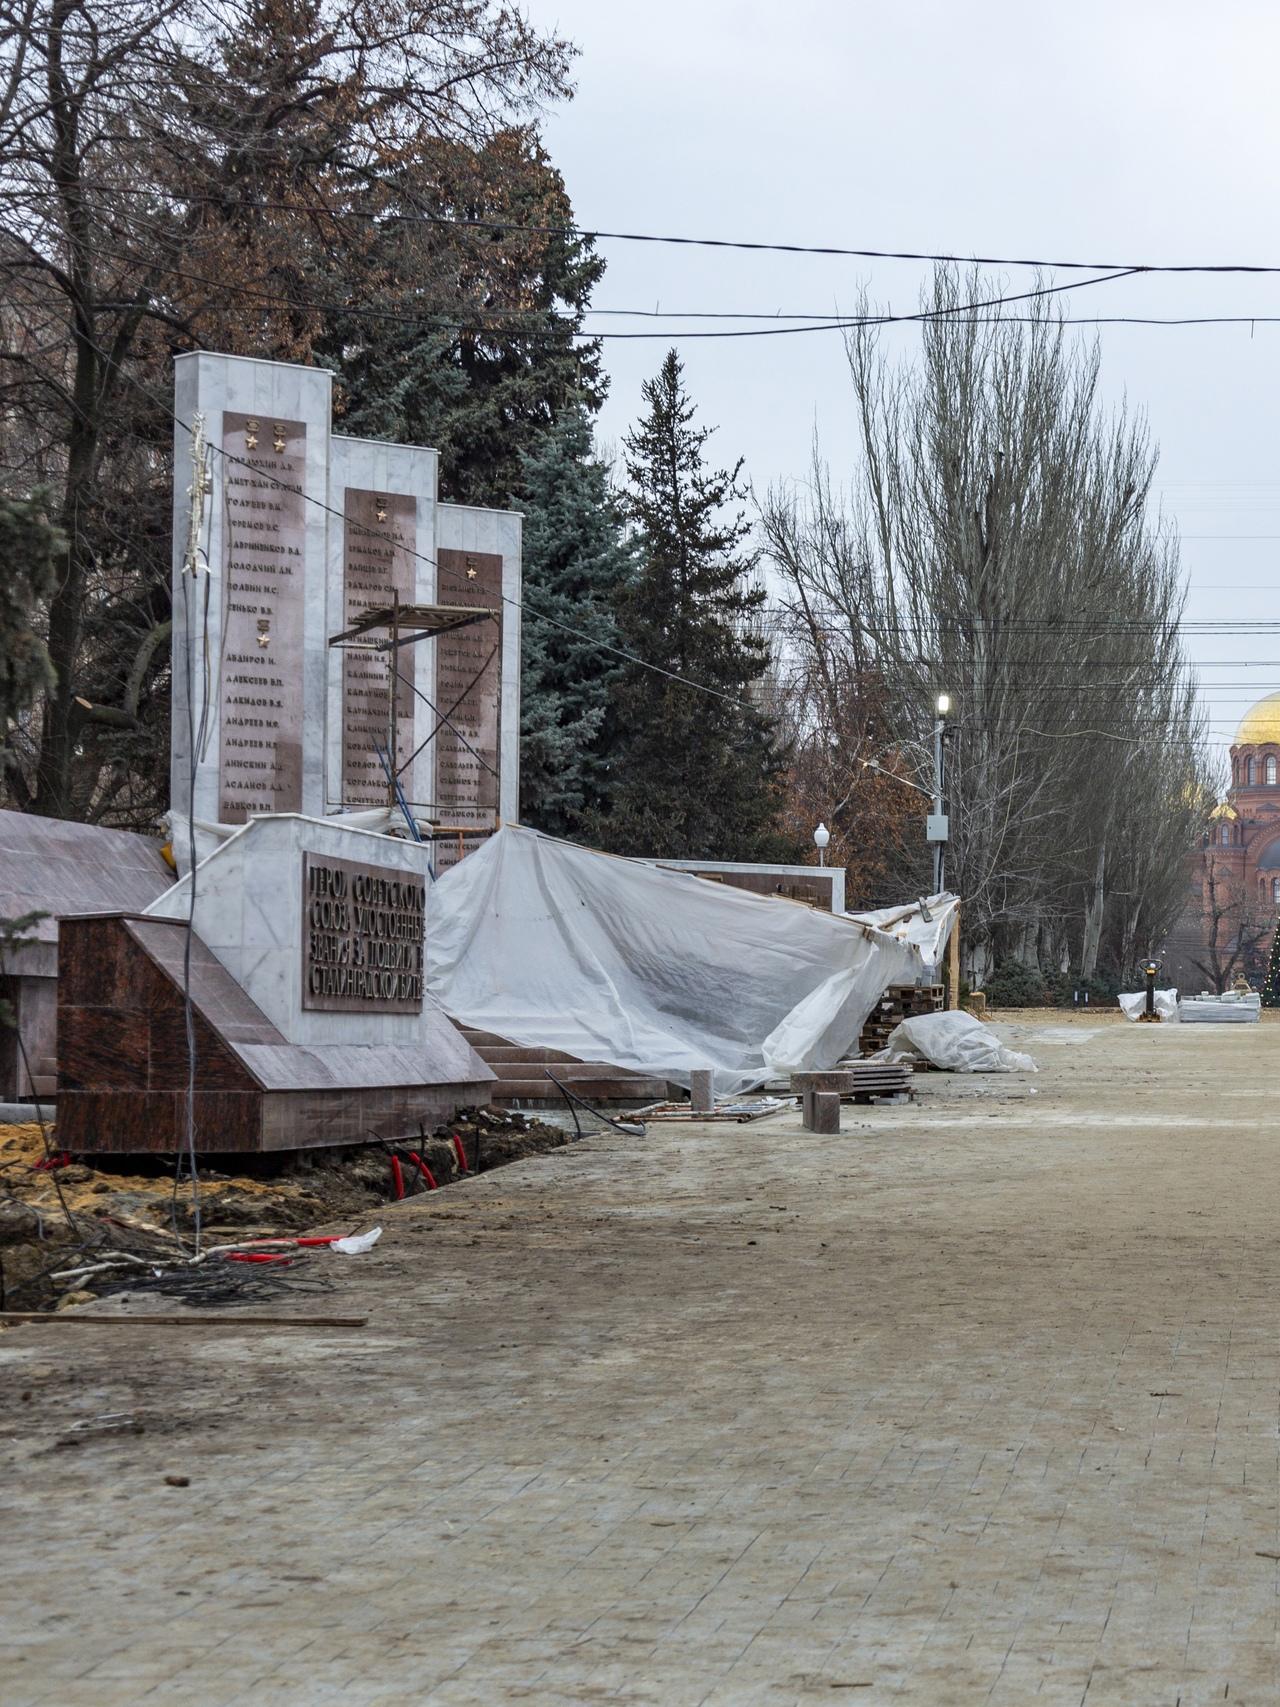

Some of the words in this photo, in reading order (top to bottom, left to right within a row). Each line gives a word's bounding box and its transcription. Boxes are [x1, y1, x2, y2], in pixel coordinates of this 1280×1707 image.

[226, 498, 266, 510] ГОЛУБЕВ
[227, 518, 264, 531] ФРЕМОВ
[348, 581, 382, 592] ЗАХАРОВ
[226, 674, 268, 686] АЛЕКСЕЕВ
[225, 717, 264, 728] АНДРЕЕВ
[225, 737, 263, 749] АНДРЕЕВ
[224, 780, 267, 791] АСЛАНОВ
[310, 866, 348, 898] ГЕРОИ
[353, 873, 426, 912] СОВЕТСКОГО
[310, 900, 352, 931] СОЮЗА
[354, 905, 426, 941] УДОСТОЕННЫЕ
[310, 931, 351, 965] ЗВАНИЯ
[353, 937, 367, 967] ЗА
[367, 939, 413, 970] ПОДВИГИ
[400, 973, 426, 1001] БИТВЕ
